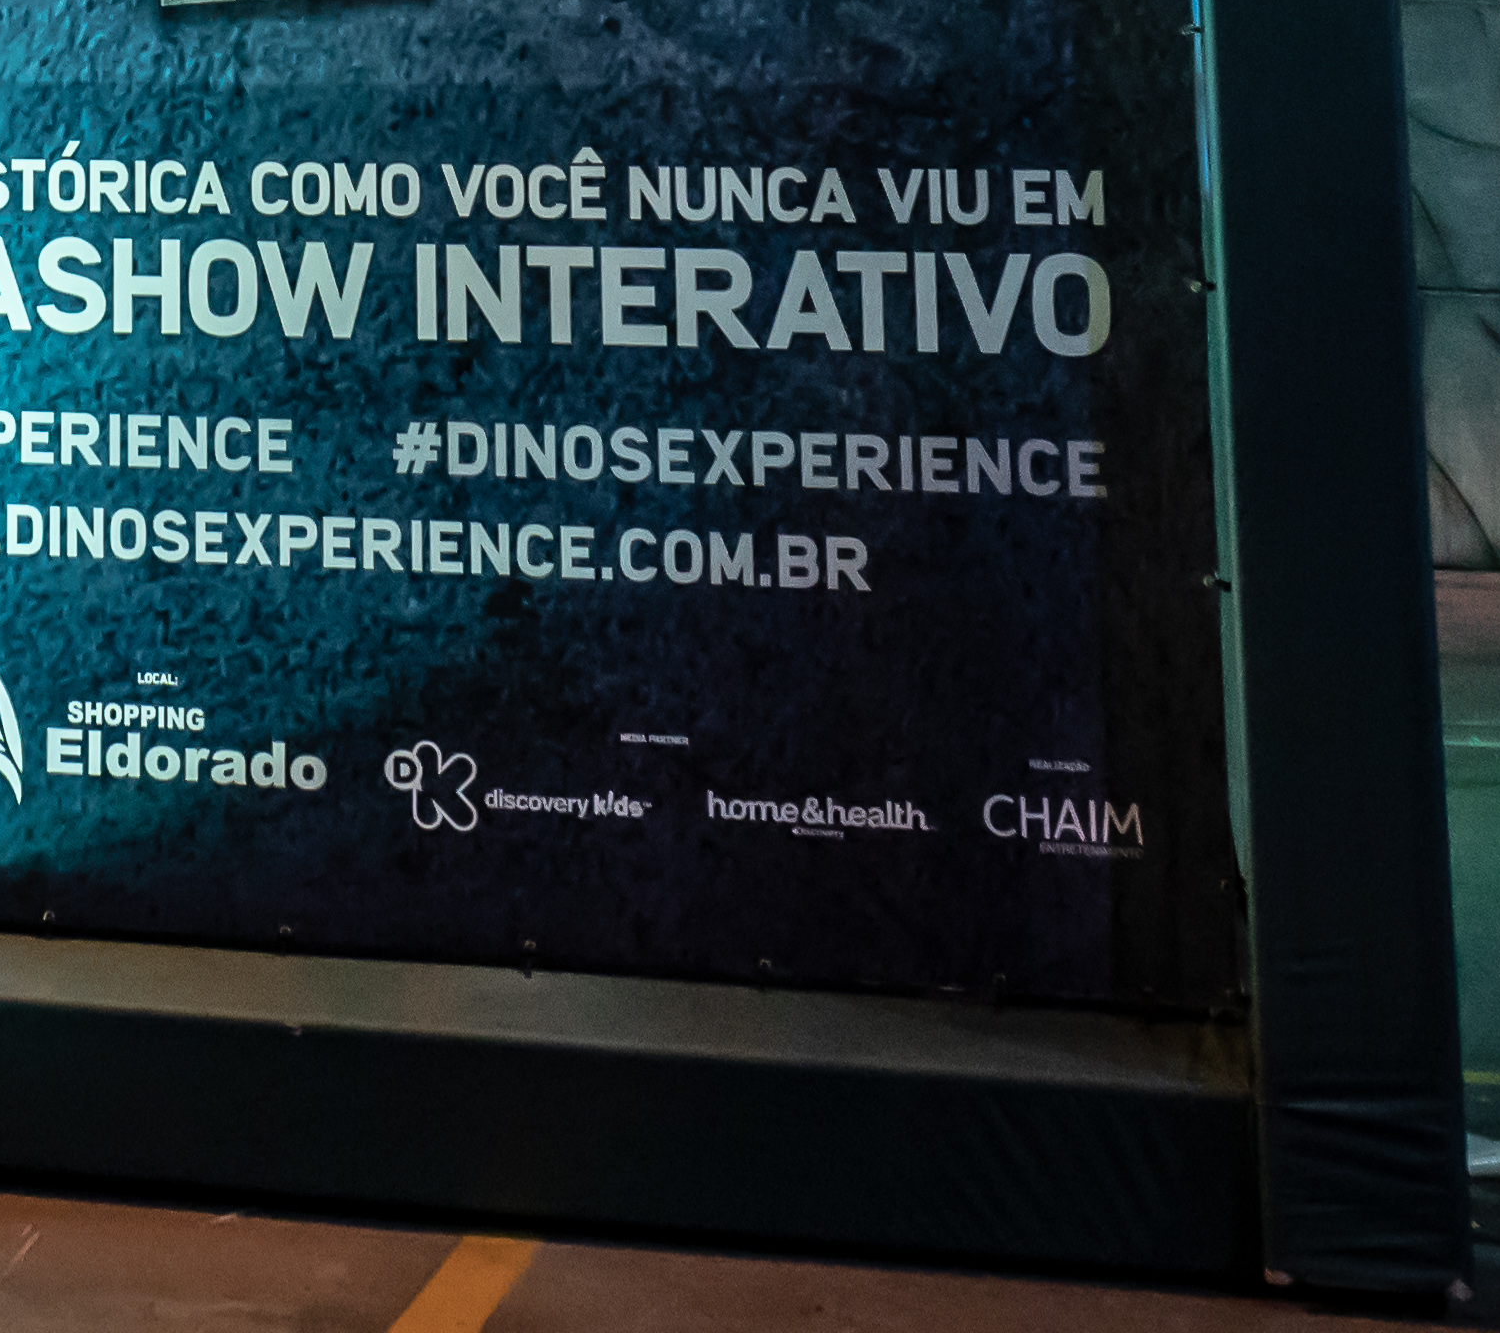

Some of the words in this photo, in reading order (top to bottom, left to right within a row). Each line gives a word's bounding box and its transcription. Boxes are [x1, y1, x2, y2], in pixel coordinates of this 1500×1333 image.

[250, 161, 422, 218] COMO
[441, 146, 608, 221] VOCÊ
[628, 165, 857, 225] NUNCA
[876, 167, 990, 225] VIU
[1013, 169, 1106, 227] EM
[415, 242, 1112, 357] INTERATIVO
[393, 421, 1108, 498] #DINOSEXPERIENCE
[137, 671, 179, 687] LOCAL:
[67, 699, 206, 731] SHOPPING
[46, 726, 328, 791] Eldorado
[484, 788, 589, 820] discovery
[983, 793, 1144, 846] CHAIM
